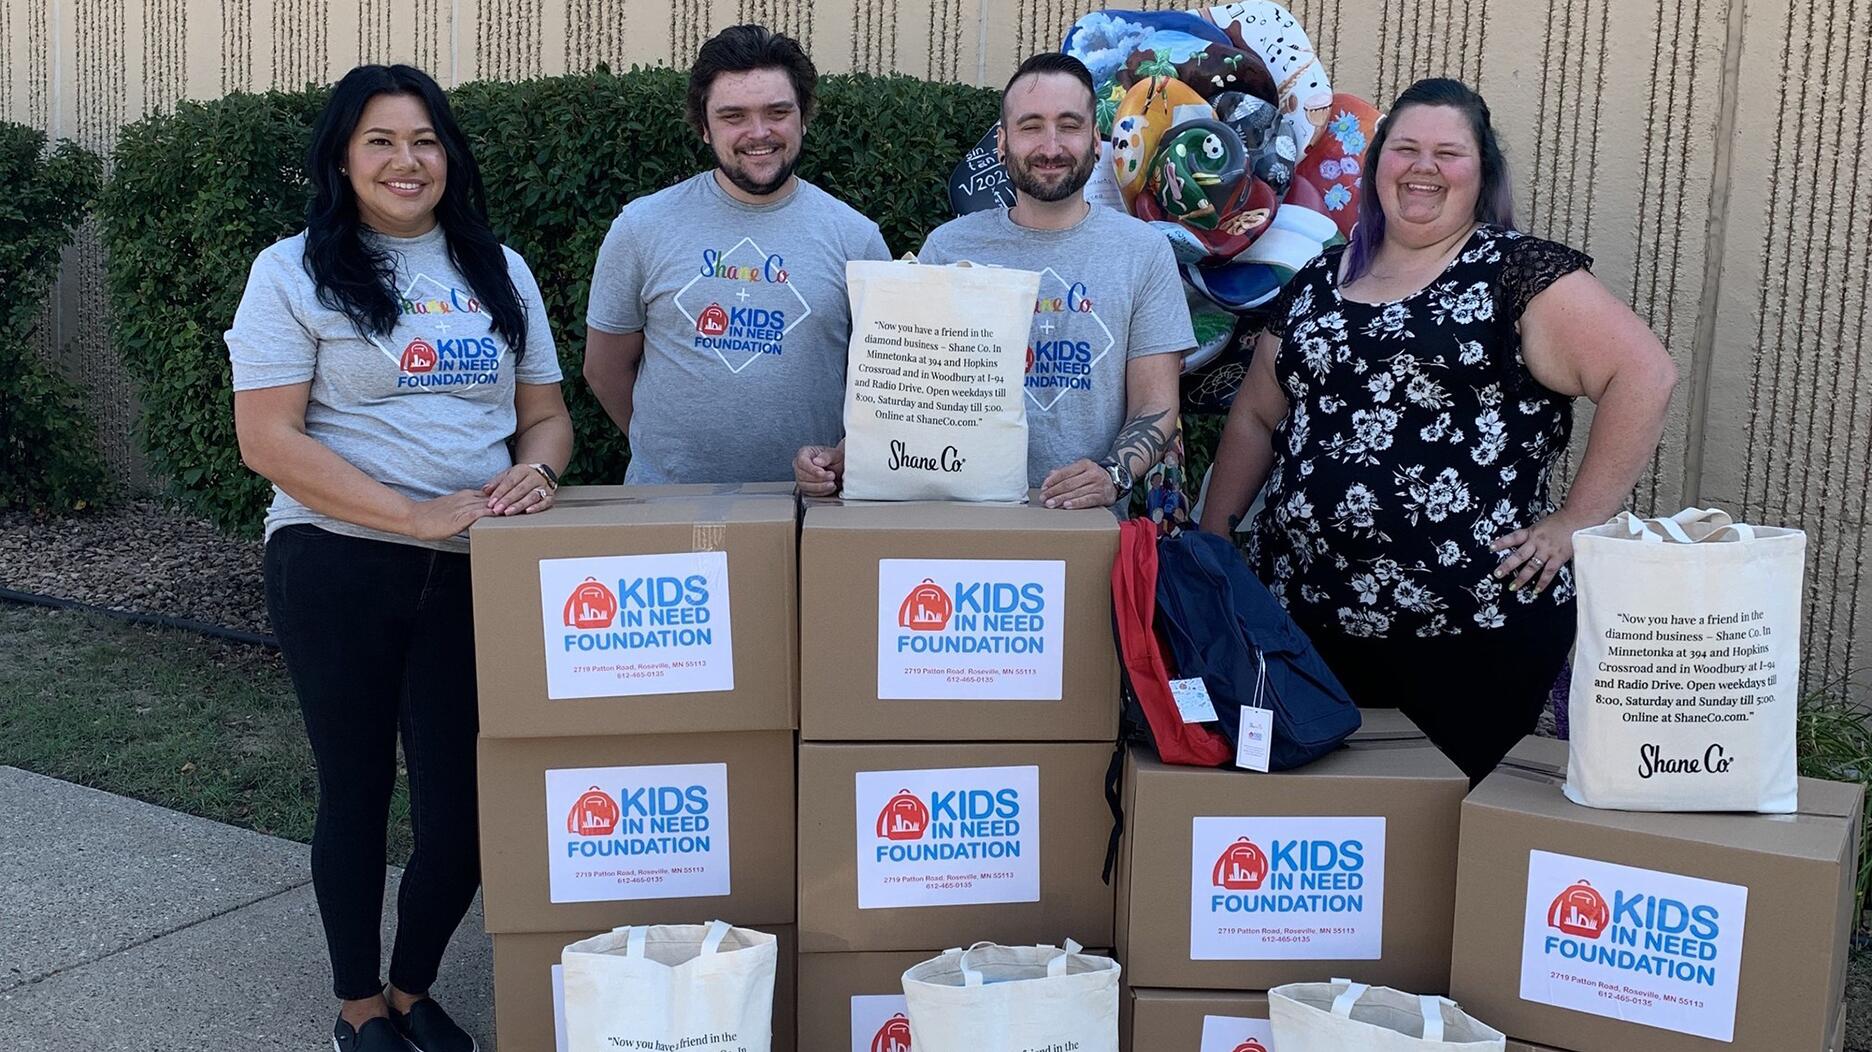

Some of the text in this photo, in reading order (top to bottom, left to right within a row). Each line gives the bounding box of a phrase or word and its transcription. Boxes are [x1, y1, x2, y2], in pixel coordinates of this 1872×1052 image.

[969, 157, 995, 170] tan
[700, 249, 790, 284] Shane Co.
[1068, 282, 1093, 313] Co.
[730, 307, 784, 329] KIDS
[729, 327, 783, 341] IN NEED
[898, 324, 912, 332] you
[915, 324, 932, 335] have
[935, 328, 939, 336] a
[942, 328, 968, 337] friend
[971, 329, 978, 337] in
[981, 329, 993, 338] the
[437, 337, 497, 359] KIDS
[695, 337, 782, 355] FOUNDATION
[865, 334, 1001, 352] diamond business Shane Co. In
[1036, 341, 1091, 362] KIDS
[439, 359, 499, 371] IN NEED
[867, 350, 916, 363] Minnetonka
[919, 356, 926, 364] at
[944, 358, 960, 367] and
[964, 359, 998, 369] Hopkins
[1036, 362, 1091, 375] IN NEED
[398, 374, 498, 387] FOUNDATION
[859, 364, 900, 376] Crossroad
[903, 369, 919, 378] and
[921, 370, 929, 379] in
[932, 372, 975, 384] Woodbury
[987, 374, 1004, 383] I-94
[855, 379, 1006, 398] and Radio Drive. Open weekdays till
[878, 395, 916, 409] Saturday
[918, 401, 934, 410] and
[936, 402, 968, 413] Sunday
[971, 403, 982, 412] till
[875, 410, 904, 421] Online
[906, 414, 914, 422] at
[888, 440, 938, 471] Shane
[619, 575, 710, 609] KIDS
[955, 582, 1044, 613] KIDS
[621, 607, 710, 627] IN NEED
[954, 614, 1044, 632] IN NEED
[1648, 616, 1667, 625] you
[1671, 614, 1696, 625] have
[1708, 613, 1738, 624] friend
[1741, 612, 1750, 622] in
[1751, 610, 1764, 621] the
[564, 628, 712, 652] FOUNDATION
[1606, 626, 1771, 641] diamond business Shane Co. In
[898, 636, 1043, 653] FOUNDATION
[1608, 644, 1769, 658] Minnetonka at 394 and Hopkins
[1599, 661, 1775, 674] Crossroad and in Woodbury at I-94
[1594, 675, 1776, 692] and Radio Drive. Open weekdays till
[1596, 695, 1775, 708] 8:00, Saturday and Sunday till 5:00.
[1623, 712, 1658, 723] Online
[1662, 714, 1672, 722] at
[1639, 743, 1701, 778] Shane
[621, 785, 709, 817] KIDS
[931, 789, 1019, 821] KIDS
[622, 816, 709, 835] IN NEED
[932, 820, 1019, 839] IN NEED
[568, 836, 710, 857] FOUNDATION
[877, 841, 1020, 862] FOUNDATION
[1271, 840, 1364, 871] KIDS
[1271, 873, 1363, 890] IN NEED
[1211, 895, 1362, 912] FOUNDATION
[1613, 890, 1719, 940] KIDS
[1611, 925, 1717, 961] IN NEED
[1545, 936, 1715, 986] FOUNDATION
[1550, 972, 1569, 980] 2719
[1571, 976, 1596, 987] Patton
[1598, 982, 1620, 992] Road,
[1623, 987, 1661, 1000] Roseville,
[1679, 998, 1703, 1008] 55113
[1598, 991, 1652, 1007] 612-465-0135
[635, 1040, 653, 1050] you
[656, 1041, 675, 1052] have
[680, 1034, 708, 1048] friend
[710, 1033, 720, 1043] in
[722, 1032, 736, 1041] the
[1065, 1041, 1079, 1051] the
